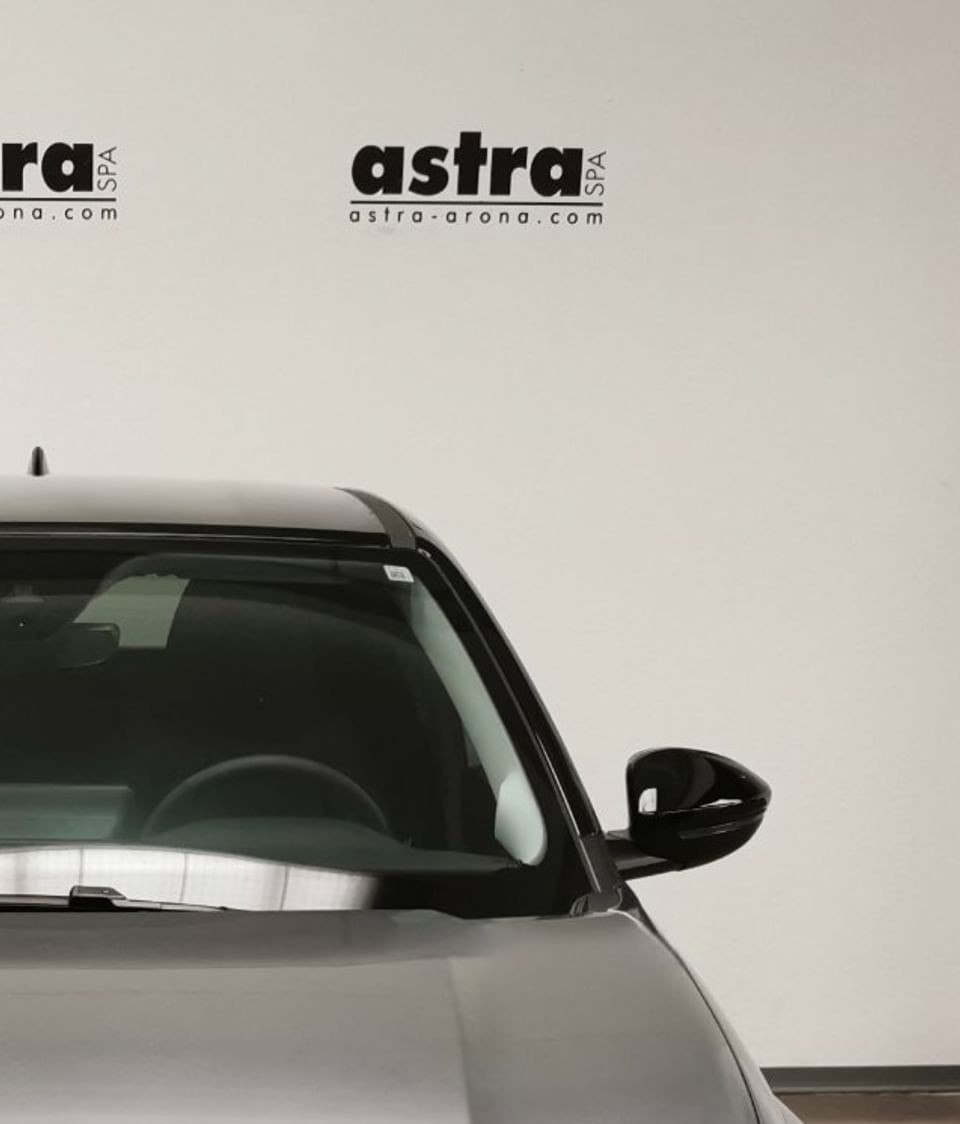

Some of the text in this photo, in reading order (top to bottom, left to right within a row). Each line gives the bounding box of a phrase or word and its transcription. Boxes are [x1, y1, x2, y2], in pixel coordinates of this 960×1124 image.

[96, 145, 118, 192] SPA
[351, 131, 607, 197] astra SPA
[349, 207, 603, 225] astra-arona.com
